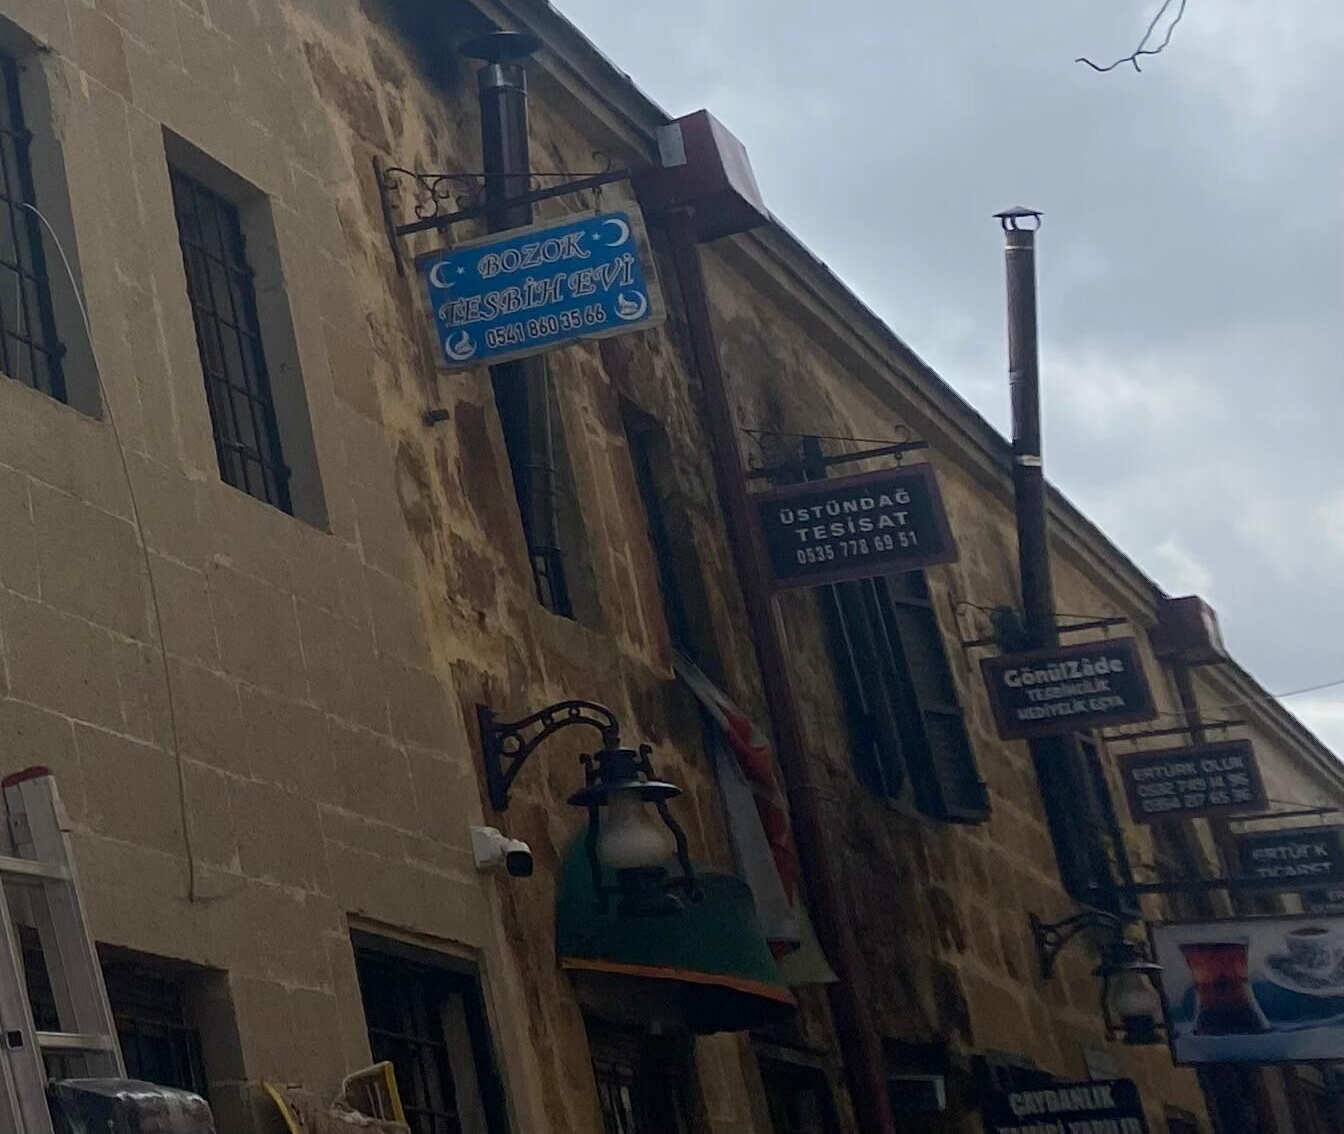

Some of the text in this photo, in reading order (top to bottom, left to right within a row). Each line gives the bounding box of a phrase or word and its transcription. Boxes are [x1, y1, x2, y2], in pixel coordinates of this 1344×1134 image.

[477, 230, 592, 279] BOZOK
[439, 253, 636, 327] TESBİH EVİ
[485, 303, 606, 349] 0541 860 35 66
[780, 488, 911, 525] ÜSTÜNDAĞ
[796, 511, 909, 542] TESİSAT
